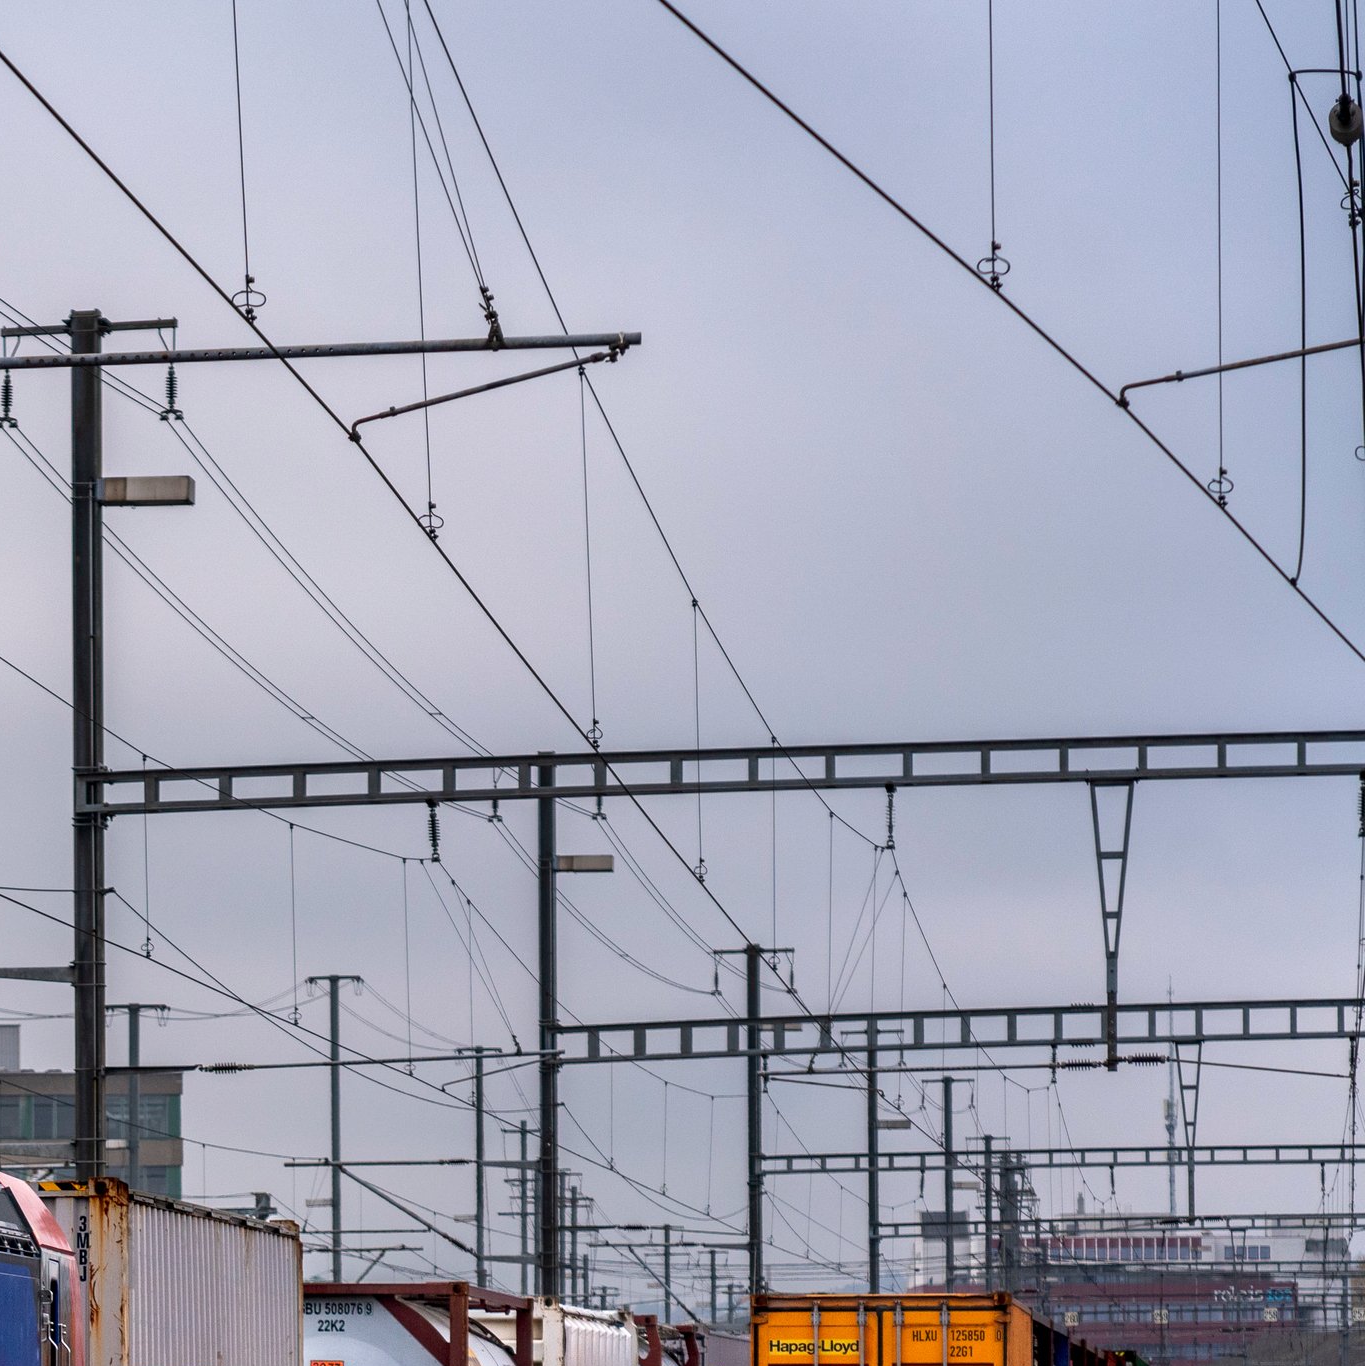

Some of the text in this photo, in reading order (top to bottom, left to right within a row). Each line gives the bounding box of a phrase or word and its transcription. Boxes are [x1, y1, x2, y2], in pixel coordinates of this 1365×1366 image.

[325, 1303, 363, 1315] 508076
[365, 1303, 372, 1315] 9
[318, 1320, 345, 1332] 22K2
[912, 1330, 937, 1341] HLXU
[951, 1330, 985, 1341] 125850
[770, 1340, 859, 1355] Hapag-Lloyd
[950, 1346, 973, 1357] 22G1
